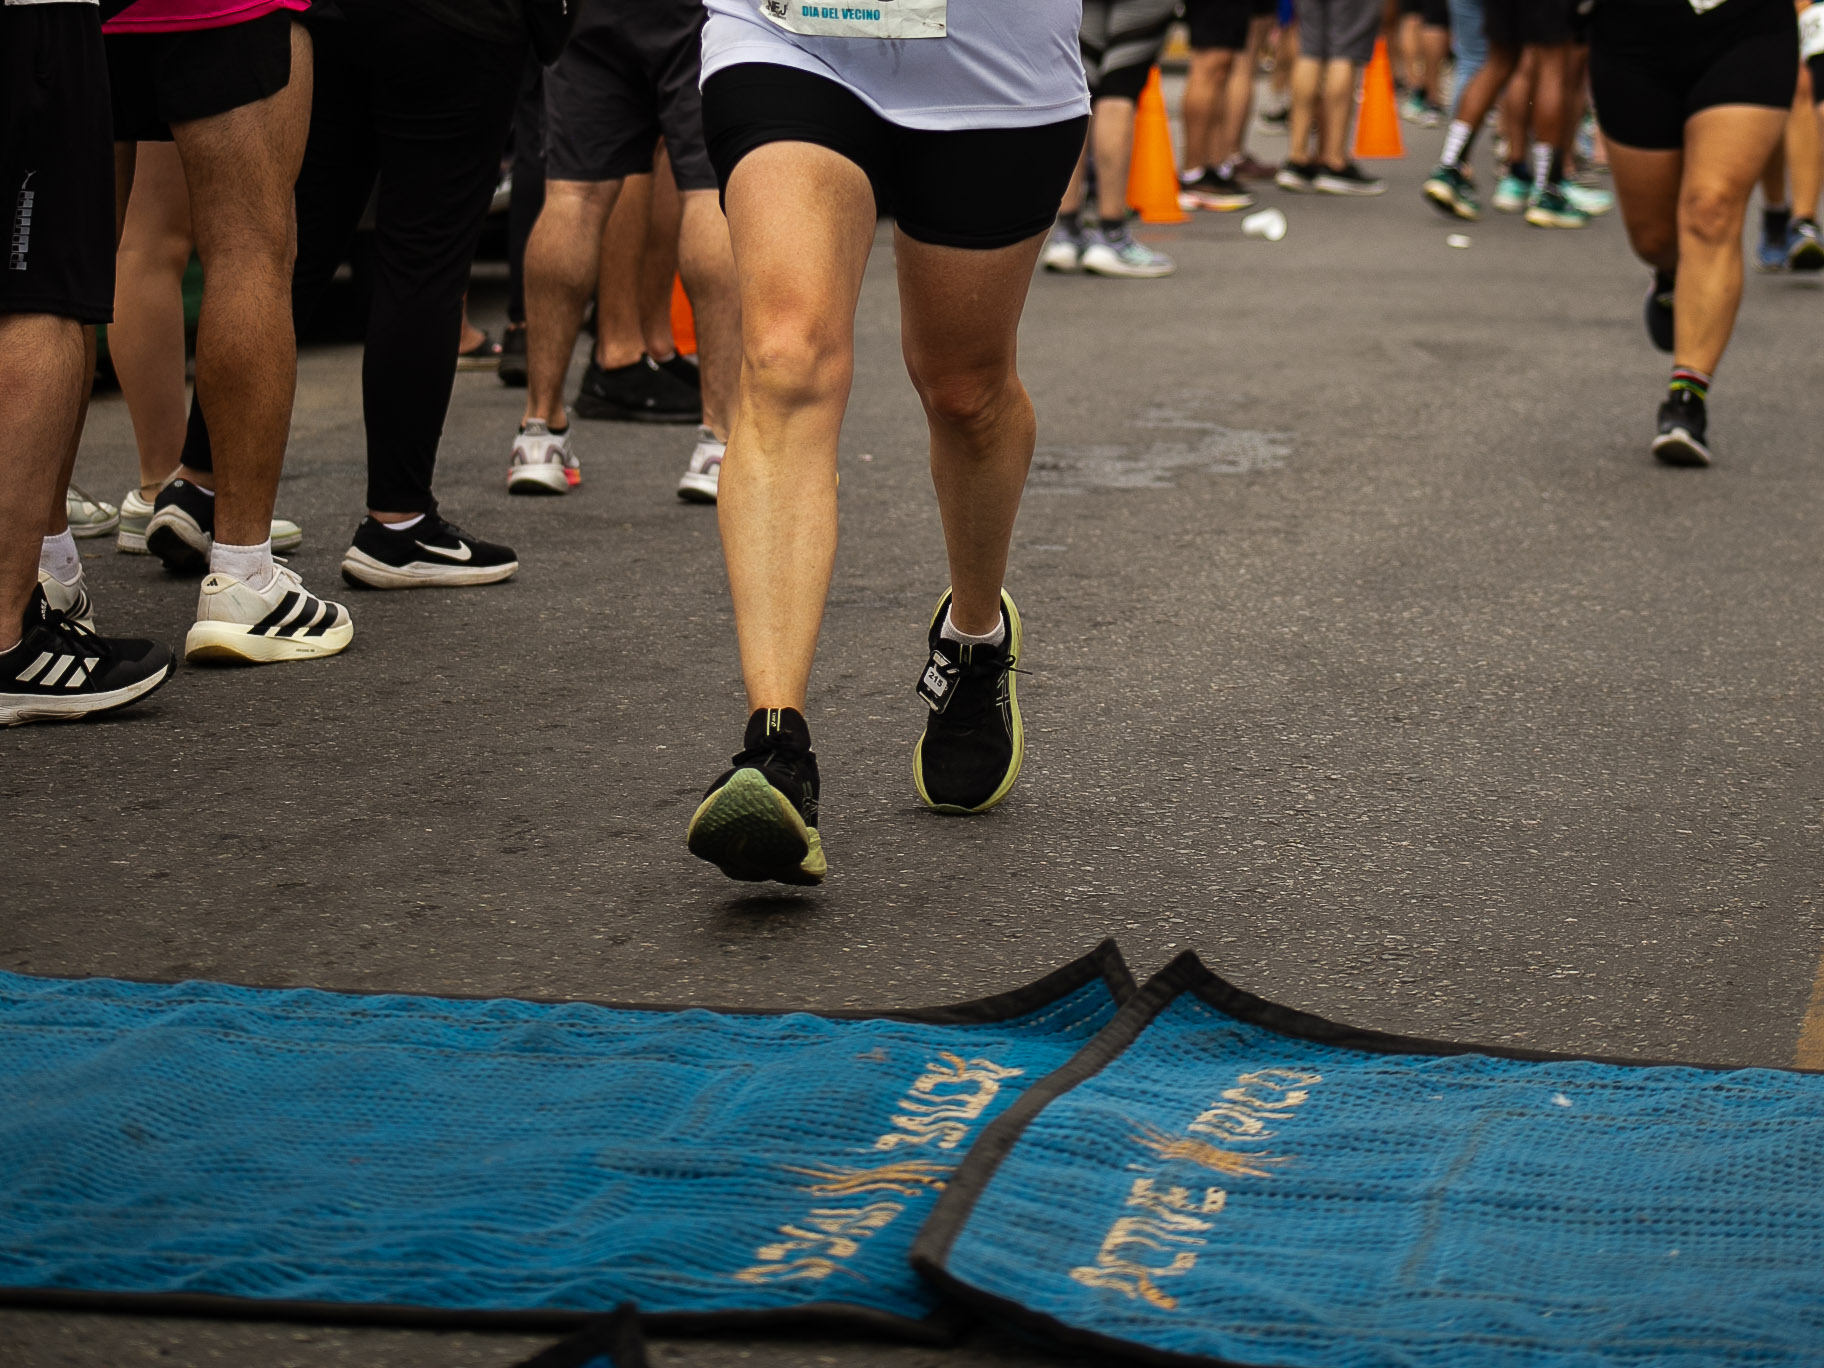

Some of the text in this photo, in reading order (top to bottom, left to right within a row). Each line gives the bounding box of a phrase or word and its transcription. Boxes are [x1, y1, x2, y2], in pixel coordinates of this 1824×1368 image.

[802, 5, 820, 18] DIA
[821, 7, 840, 20] DEL
[841, 8, 881, 21] VECINO
[928, 671, 943, 687] 215
